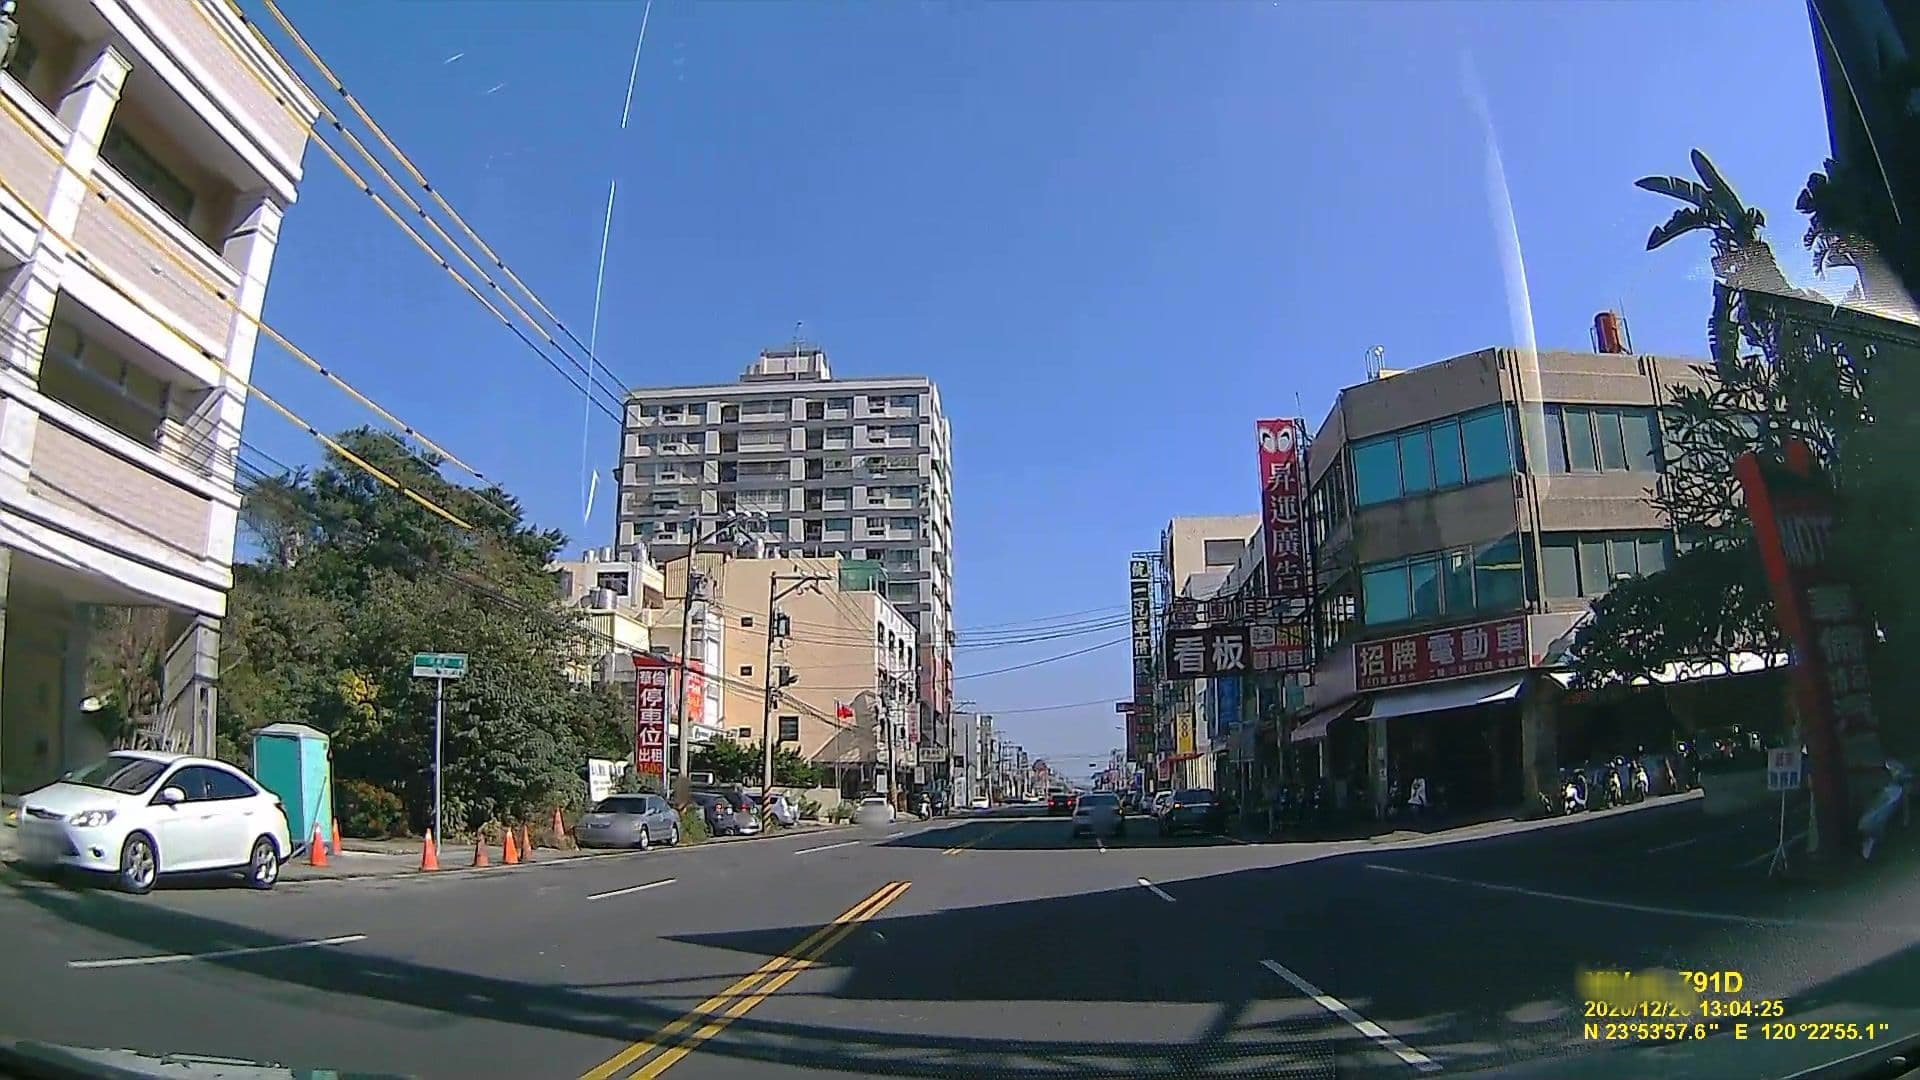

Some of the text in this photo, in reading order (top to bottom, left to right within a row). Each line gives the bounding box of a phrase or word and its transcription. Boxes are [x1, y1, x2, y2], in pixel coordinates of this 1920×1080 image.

[1268, 462, 1302, 590] 昇運廣告
[1174, 635, 1245, 673] 看板
[1360, 640, 1416, 676] 招牌
[1428, 623, 1525, 664] 電動車
[640, 688, 663, 746] 停車位
[639, 749, 663, 762] 出租
